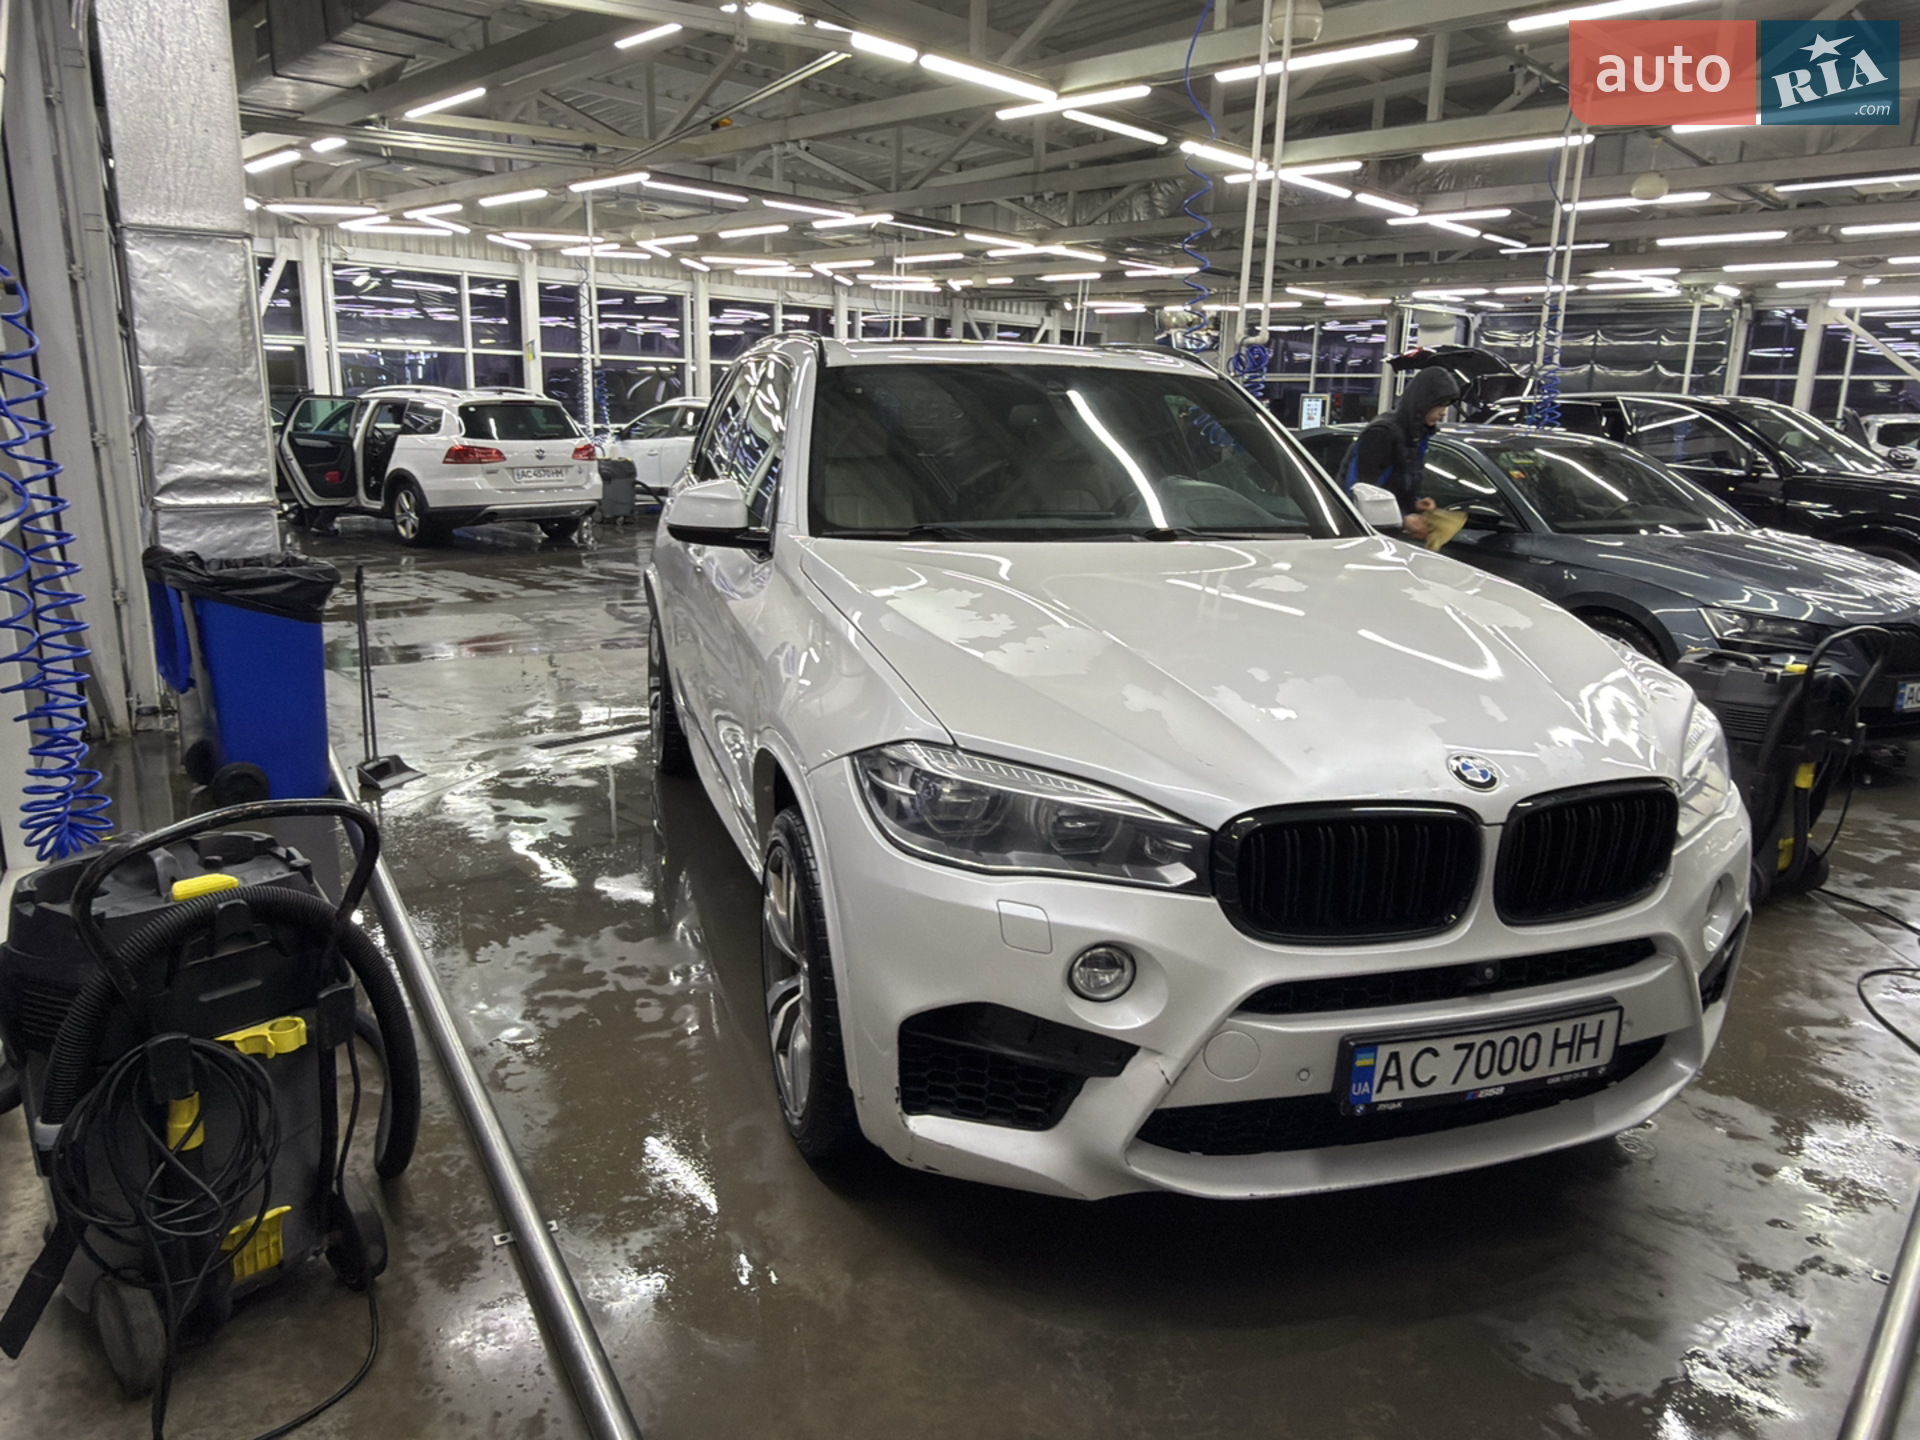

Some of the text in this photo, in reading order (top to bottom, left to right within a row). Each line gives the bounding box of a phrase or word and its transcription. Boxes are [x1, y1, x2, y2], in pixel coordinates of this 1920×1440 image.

[1375, 1019, 1605, 1094] AC 7000 HH
[1351, 1081, 1371, 1096] UA
